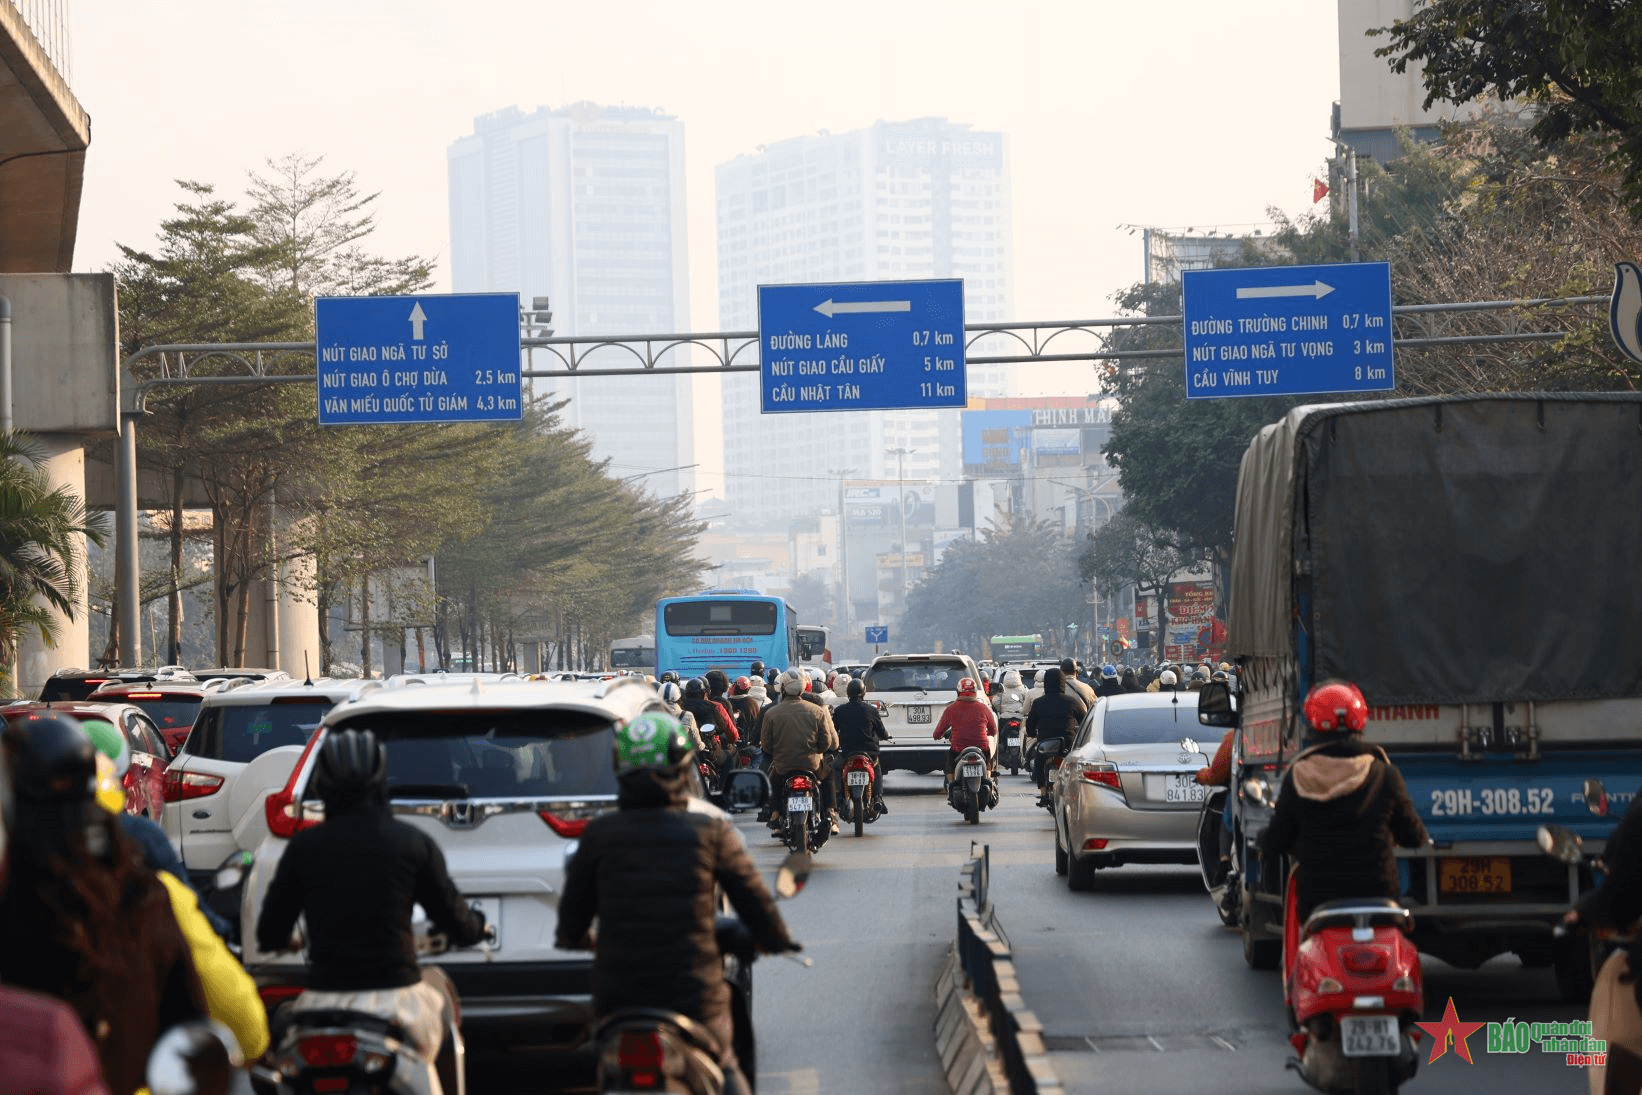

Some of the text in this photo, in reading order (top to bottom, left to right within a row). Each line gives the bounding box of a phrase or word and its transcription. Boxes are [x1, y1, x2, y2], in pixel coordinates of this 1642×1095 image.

[1191, 313, 1328, 335] ĐƯỜNG TRƯỜNG CHINH
[1365, 314, 1383, 328] km
[770, 330, 848, 350] ĐƯỜNG LÁNG
[935, 331, 953, 345] km
[1354, 340, 1384, 355] 3 km
[323, 340, 448, 362] NÚT GIAO NGÃ TƯ SỞ
[1193, 341, 1333, 361] NÚT GIAO NGÃ TƯ VỌNG
[772, 353, 885, 376] NÚT GIAO CẦU GIẤY
[924, 357, 954, 371] 5 km
[1355, 366, 1385, 380] 8 km
[323, 366, 448, 388] NÚT GIAO Ô CHỢ DỪA
[475, 370, 515, 385] 2.5 km
[1194, 368, 1278, 387] CẦU VĨNH TUY
[772, 382, 860, 402] CẦU NHẬT TÂN
[921, 383, 955, 398] 11 km
[352, 393, 380, 412] MIẾU
[384, 392, 414, 412] QUỐC
[419, 392, 433, 411] TỬ
[438, 393, 467, 411] GIÁM
[477, 396, 516, 410] 4.3 km
[1431, 788, 1555, 816] 29H-308.52
